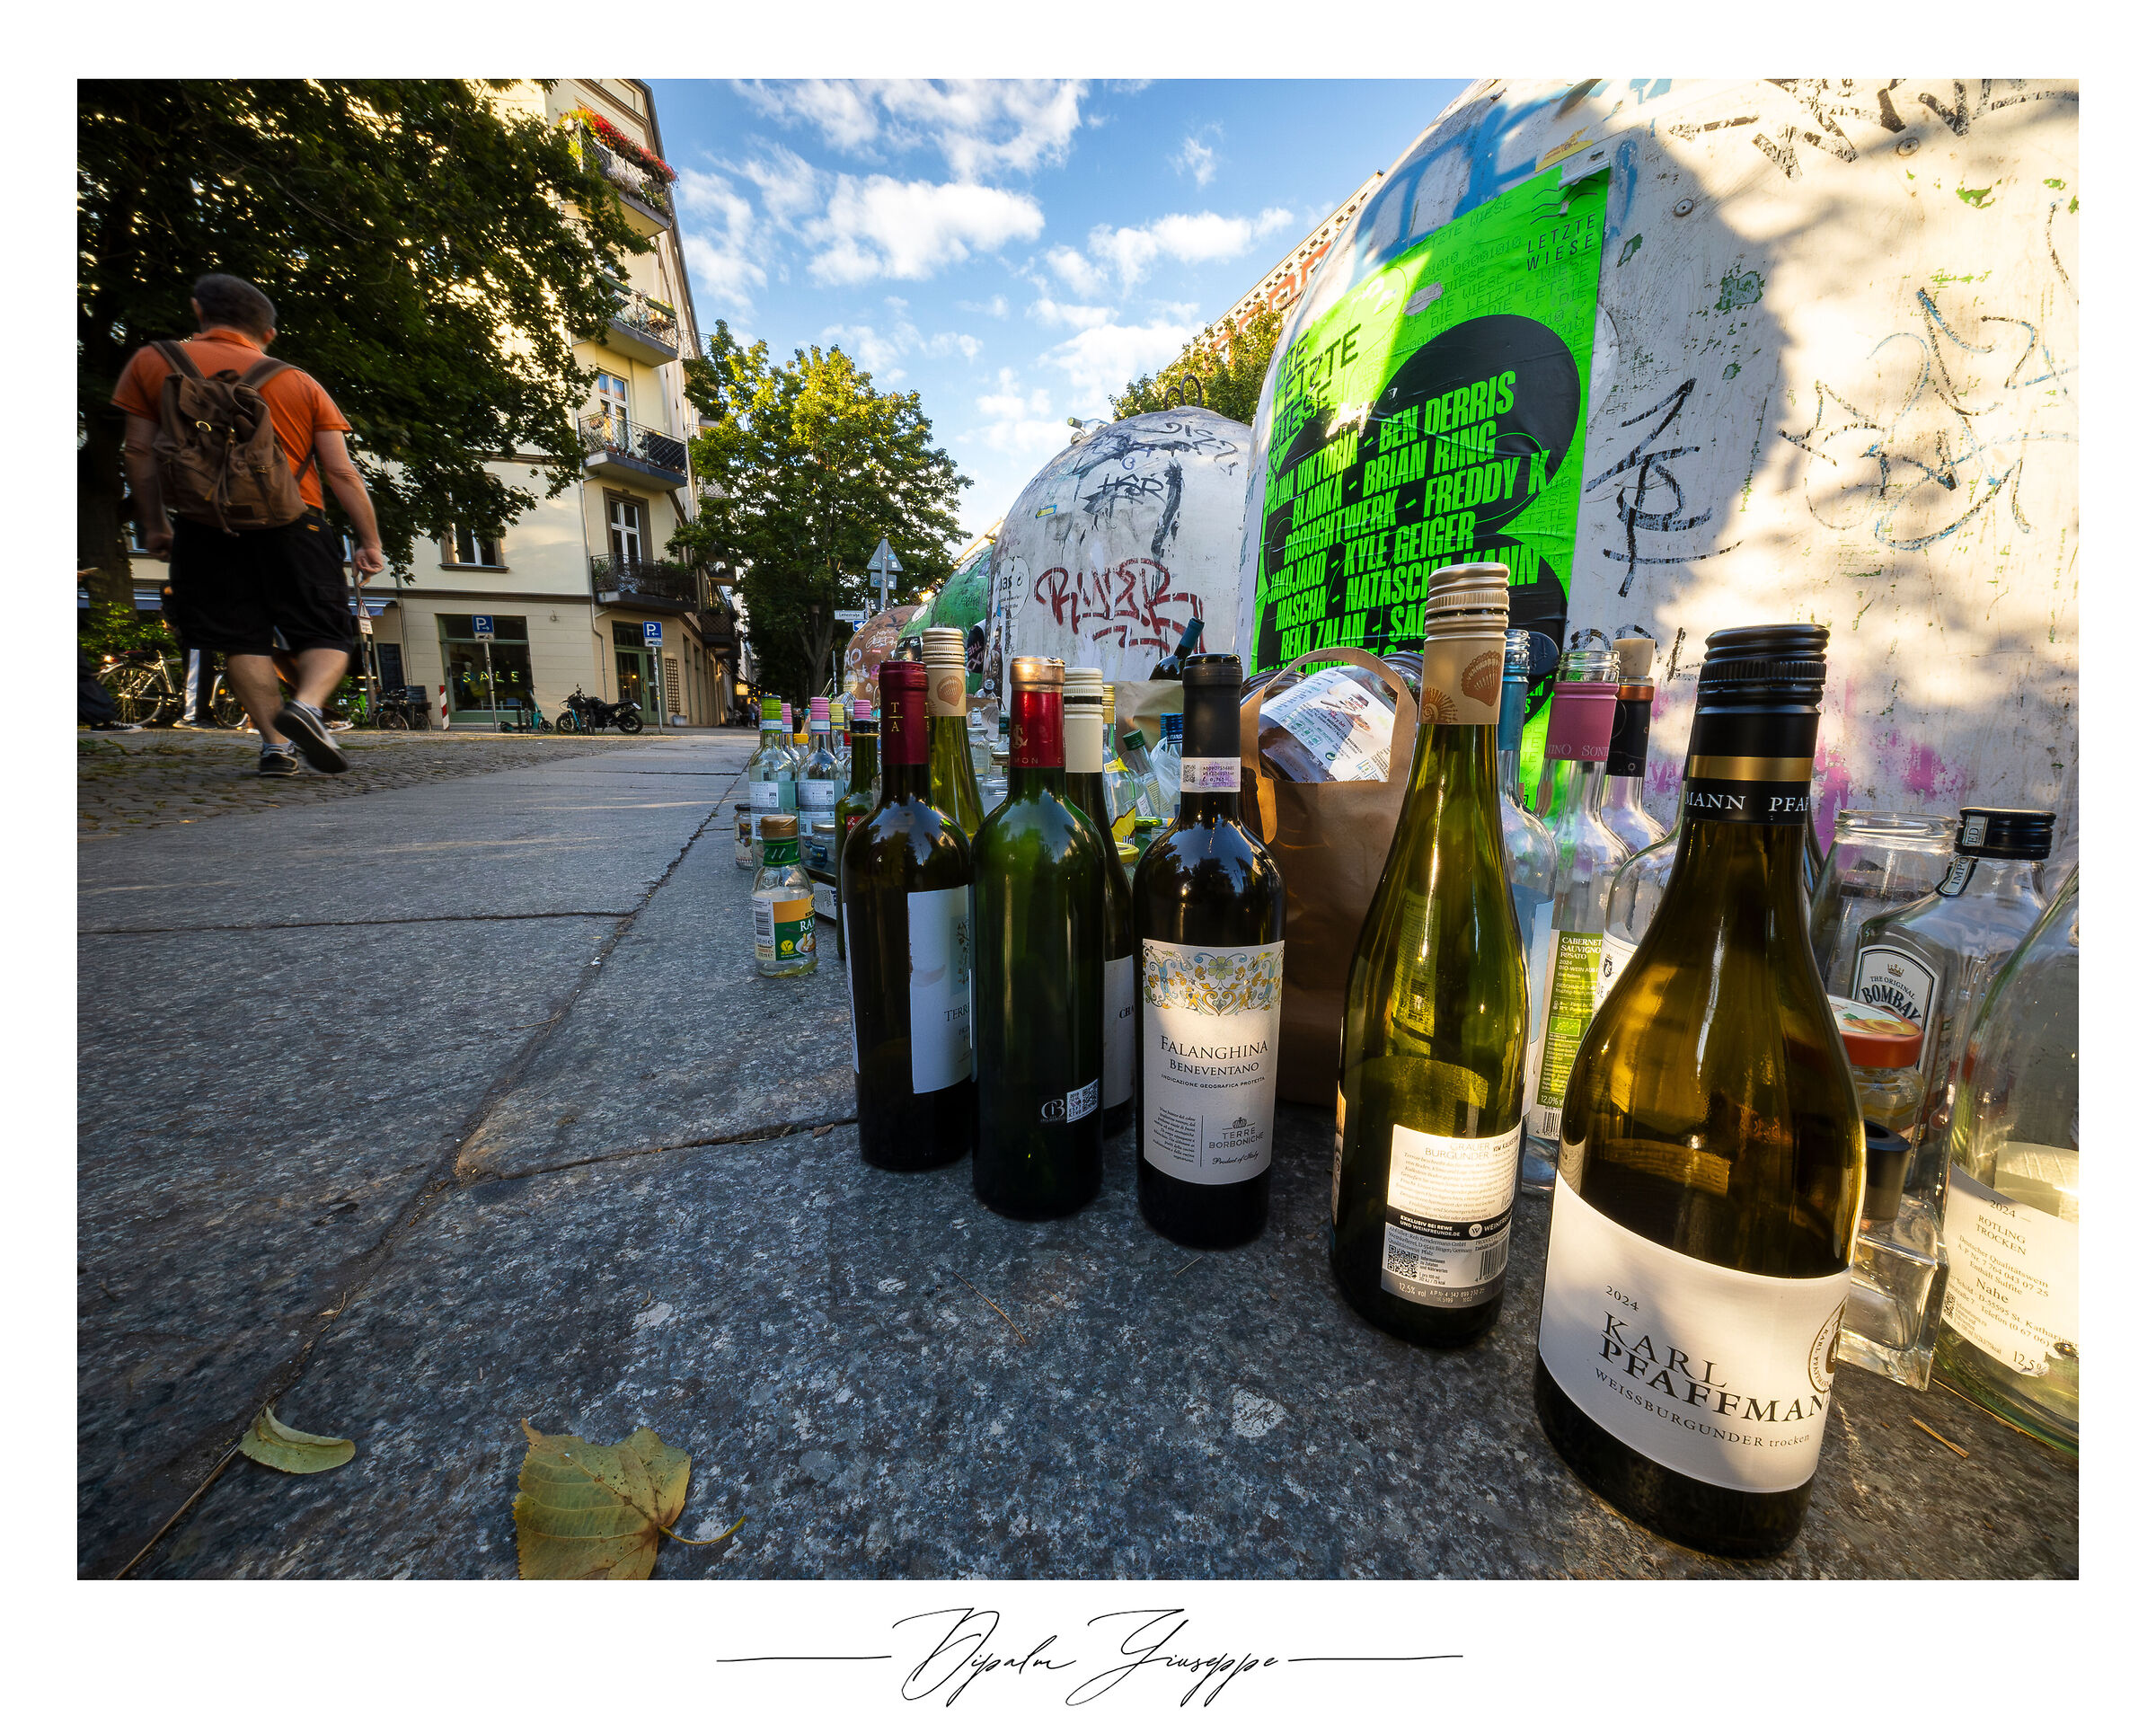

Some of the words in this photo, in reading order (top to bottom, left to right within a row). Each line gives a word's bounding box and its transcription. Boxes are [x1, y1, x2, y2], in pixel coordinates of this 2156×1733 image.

[1527, 213, 1596, 253] LETZTE
[1526, 233, 1594, 271] WIESE
[1296, 429, 1358, 495] VIKTORIA
[1379, 402, 1418, 455] BEN
[1425, 370, 1516, 438] DERRIS
[1291, 470, 1343, 531] BLANKA
[1362, 438, 1428, 499] BRIAN
[1432, 419, 1498, 475] RING
[1422, 455, 1523, 518] FREDDY
[1527, 449, 1551, 496] K
[1266, 549, 1328, 606] JAKOJAKO
[1343, 529, 1390, 578] KYLE
[1392, 510, 1476, 566] GEIGER
[1275, 588, 1327, 632] MASCHA
[475, 617, 487, 631] P
[646, 623, 657, 636] P
[1312, 610, 1367, 652] ZALAN
[463, 670, 520, 683] SALE
[1560, 945, 1602, 954] SAUVIGNO
[1560, 951, 1587, 959] ROSATO
[1561, 937, 1603, 947] CABERNET
[1869, 975, 1883, 984] THE
[1883, 976, 1915, 1001] ORIGINAL
[1860, 983, 1922, 1021] BOMBAY
[1160, 1034, 1268, 1060] FALANGHINA
[1169, 1058, 1259, 1076] BENEVENTANO
[1161, 1073, 1198, 1088] INDICAZIONE
[1240, 1076, 1266, 1087] PROTETTA
[1208, 1131, 1265, 1149] BORBONICHE
[1222, 1127, 1257, 1140] TERRE
[1450, 1142, 1490, 1151] GRAUER
[1212, 1156, 1237, 1166] Product
[1425, 1147, 1489, 1161] BURGUNDER
[1989, 1198, 2017, 1219] 2024
[1400, 1220, 1412, 1228] UND
[1412, 1225, 1461, 1237] WEINFREUNDE.DE
[1975, 1223, 2027, 1256] TROCKEN
[1978, 1214, 2027, 1244] ROTLING
[1604, 1285, 1640, 1313] 2024
[1975, 1277, 2010, 1304] Nahe
[1602, 1310, 1728, 1389] KARL
[1598, 1332, 1824, 1423] PFAFFMAN
[1594, 1366, 1765, 1447] WEISSBURGUNDER
[1768, 1433, 1811, 1448] trocken
